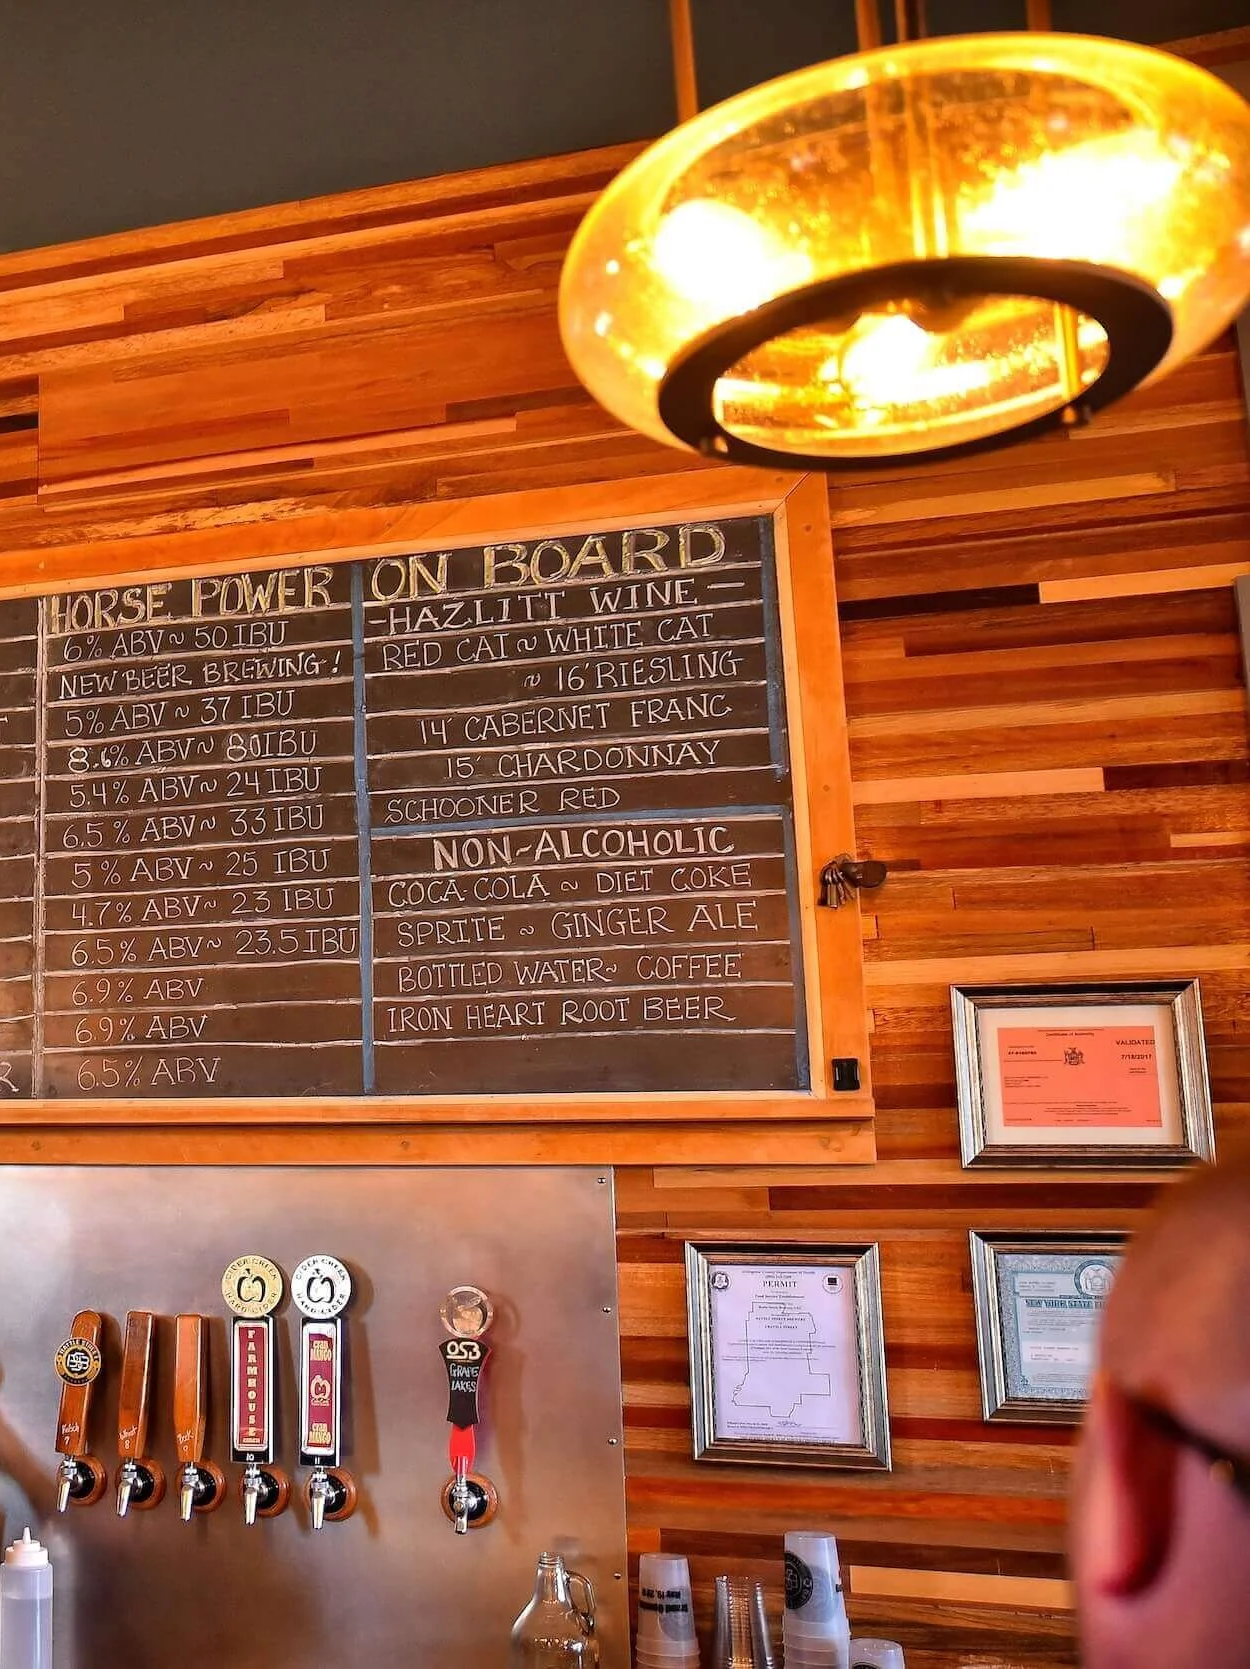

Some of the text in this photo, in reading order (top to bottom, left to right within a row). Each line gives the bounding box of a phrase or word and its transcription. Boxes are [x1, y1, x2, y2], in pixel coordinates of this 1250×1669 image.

[370, 523, 725, 601] ON BOARD
[51, 567, 334, 633] HORSE POWER
[589, 577, 697, 615] WINE
[63, 621, 289, 661] 6% ABV 50 IBU
[383, 614, 715, 670] RED CAT WHITE CAT
[59, 670, 118, 700] NEW
[123, 664, 192, 692] BEER
[596, 651, 744, 688] RIESLING
[65, 690, 295, 738] 5% ABV 37 IBU
[464, 703, 610, 742] CABERNET
[631, 694, 732, 727] FRANC
[135, 738, 196, 765] ABV
[498, 740, 721, 777] CHARDONNAY
[69, 767, 322, 808] 5.4% ABV 24 IBU
[385, 786, 620, 822] SCHOONER RED
[62, 804, 324, 848] 6.5% ABV 33 IBU
[72, 848, 332, 889] 5% ABV 25 IBU
[597, 868, 653, 894] DIET
[671, 863, 751, 891] COKE
[71, 887, 334, 927] 4.7% ABV 23 IBU
[398, 900, 757, 947] SPRITE GINGER ALE
[71, 937, 136, 966] 6.5%
[148, 936, 204, 962] ABV
[399, 963, 502, 992] BOTTLED
[637, 953, 741, 980] COFFEE
[72, 978, 204, 1006] 6.9% ABV
[75, 1014, 208, 1044] 6.9% ABV
[389, 996, 736, 1032] IRON HEART ROOT BEER
[78, 1056, 221, 1090] 6.5% ABV
[247, 1330, 258, 1436] FARMHOUSE
[450, 1363, 479, 1378] GRAPE
